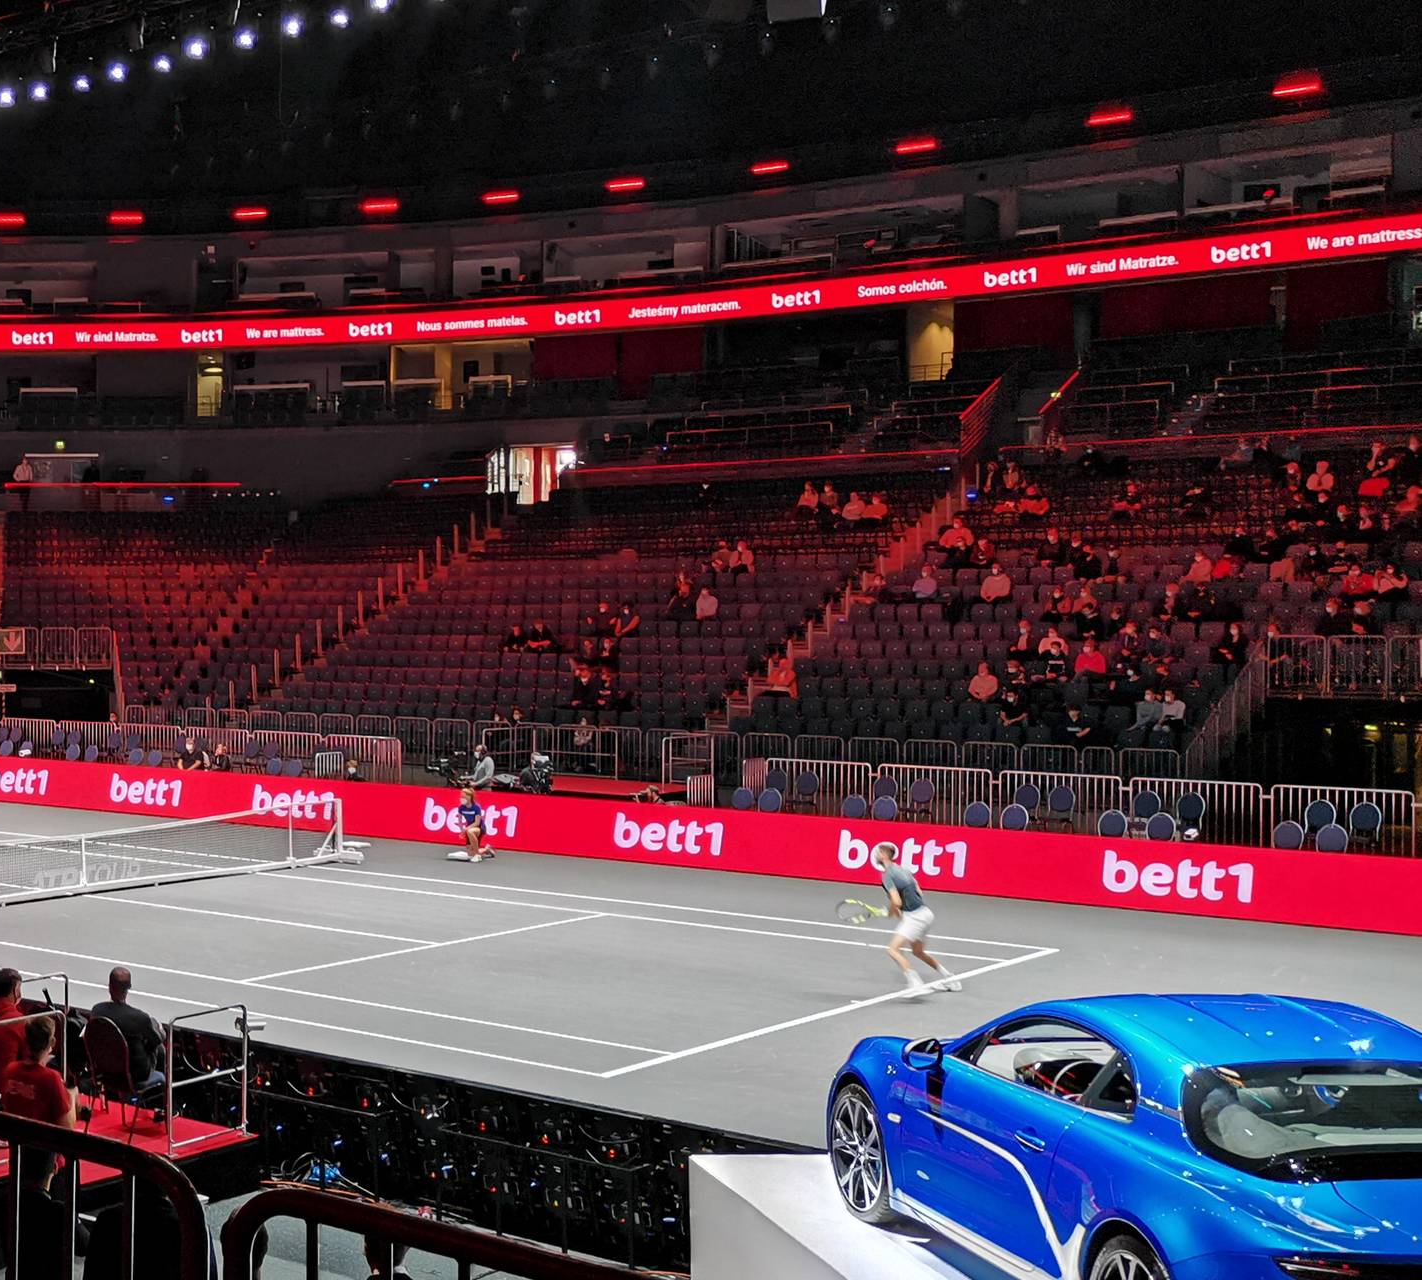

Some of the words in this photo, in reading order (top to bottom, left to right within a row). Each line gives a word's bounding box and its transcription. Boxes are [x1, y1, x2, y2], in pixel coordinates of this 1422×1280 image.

[1210, 240, 1272, 264] bett1
[1306, 235, 1329, 251] We
[1331, 235, 1356, 248] are
[1065, 262, 1088, 277] Wir
[1089, 258, 1117, 274] sind
[1118, 254, 1179, 271] Matratze.
[983, 266, 1037, 288] bett1
[857, 284, 897, 298] Somos
[898, 277, 948, 294] colchón.
[680, 300, 742, 315] materacem.
[771, 289, 821, 309] bett1
[416, 320, 443, 332] Nous
[443, 319, 486, 331] sommes
[486, 314, 529, 328] matelas.
[554, 308, 601, 326] bett1
[11, 330, 54, 346] bett1
[74, 331, 92, 343] Wir
[92, 330, 114, 343] sind
[114, 331, 159, 343] Matratze.
[180, 328, 223, 344] bett1
[245, 327, 262, 339] We
[262, 329, 279, 339] are
[279, 326, 325, 338] mattress.
[348, 321, 393, 338] bett1
[110, 773, 183, 807] bett1
[252, 784, 335, 821] bett1
[423, 797, 518, 838] bet1
[613, 812, 724, 856] bett1
[1102, 850, 1254, 904] bett1
